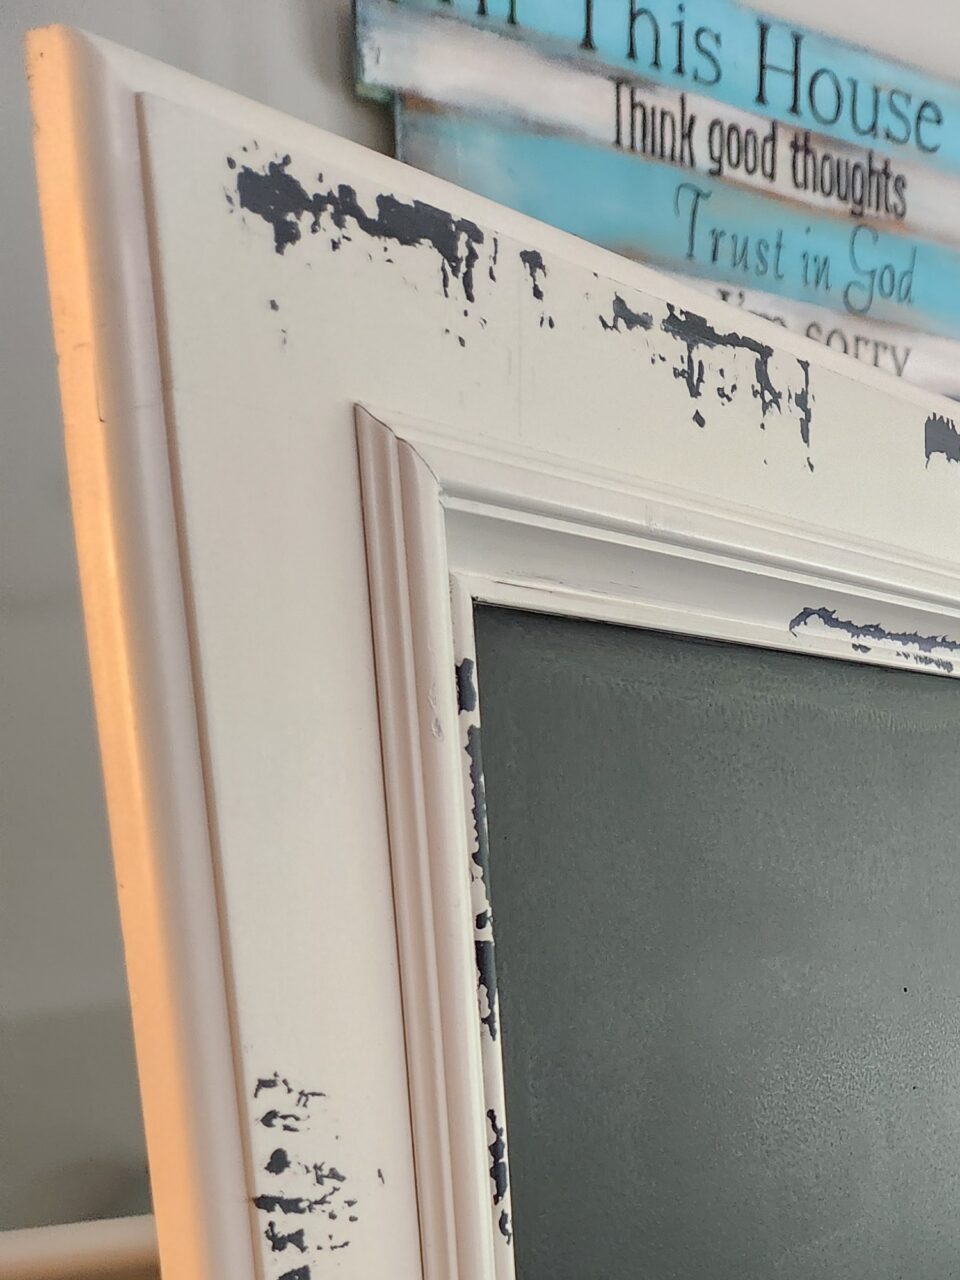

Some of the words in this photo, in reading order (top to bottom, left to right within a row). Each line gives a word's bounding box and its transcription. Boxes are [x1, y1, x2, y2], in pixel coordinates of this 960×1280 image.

[612, 79, 697, 168] Think
[708, 118, 778, 183] good
[790, 131, 908, 219] thoughts
[754, 19, 944, 154] House
[674, 182, 786, 281] Trust
[800, 225, 833, 292] in
[843, 222, 918, 315] God
